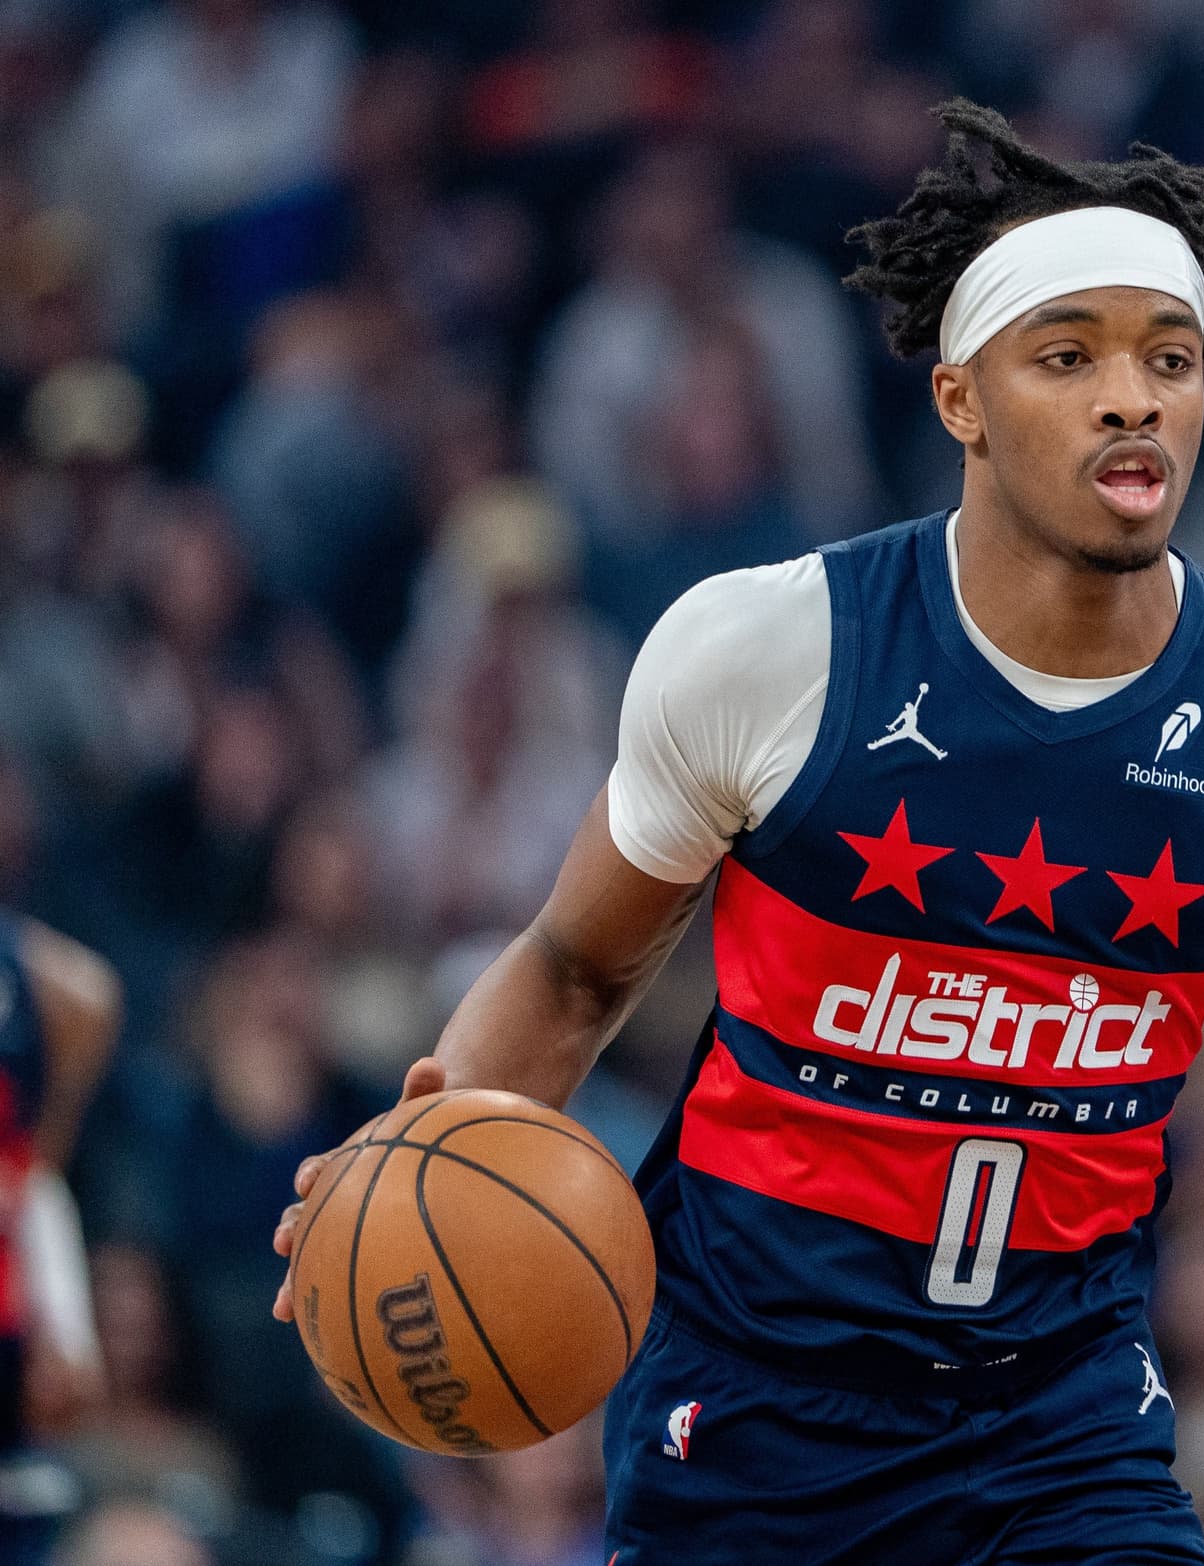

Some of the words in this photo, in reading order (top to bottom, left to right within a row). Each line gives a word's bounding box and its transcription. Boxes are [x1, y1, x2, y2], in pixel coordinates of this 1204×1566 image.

[927, 971, 987, 998] THE
[813, 952, 1171, 1069] district
[799, 1065, 848, 1089] OF
[924, 1136, 1025, 1308] 0
[663, 1443, 678, 1457] NBA
